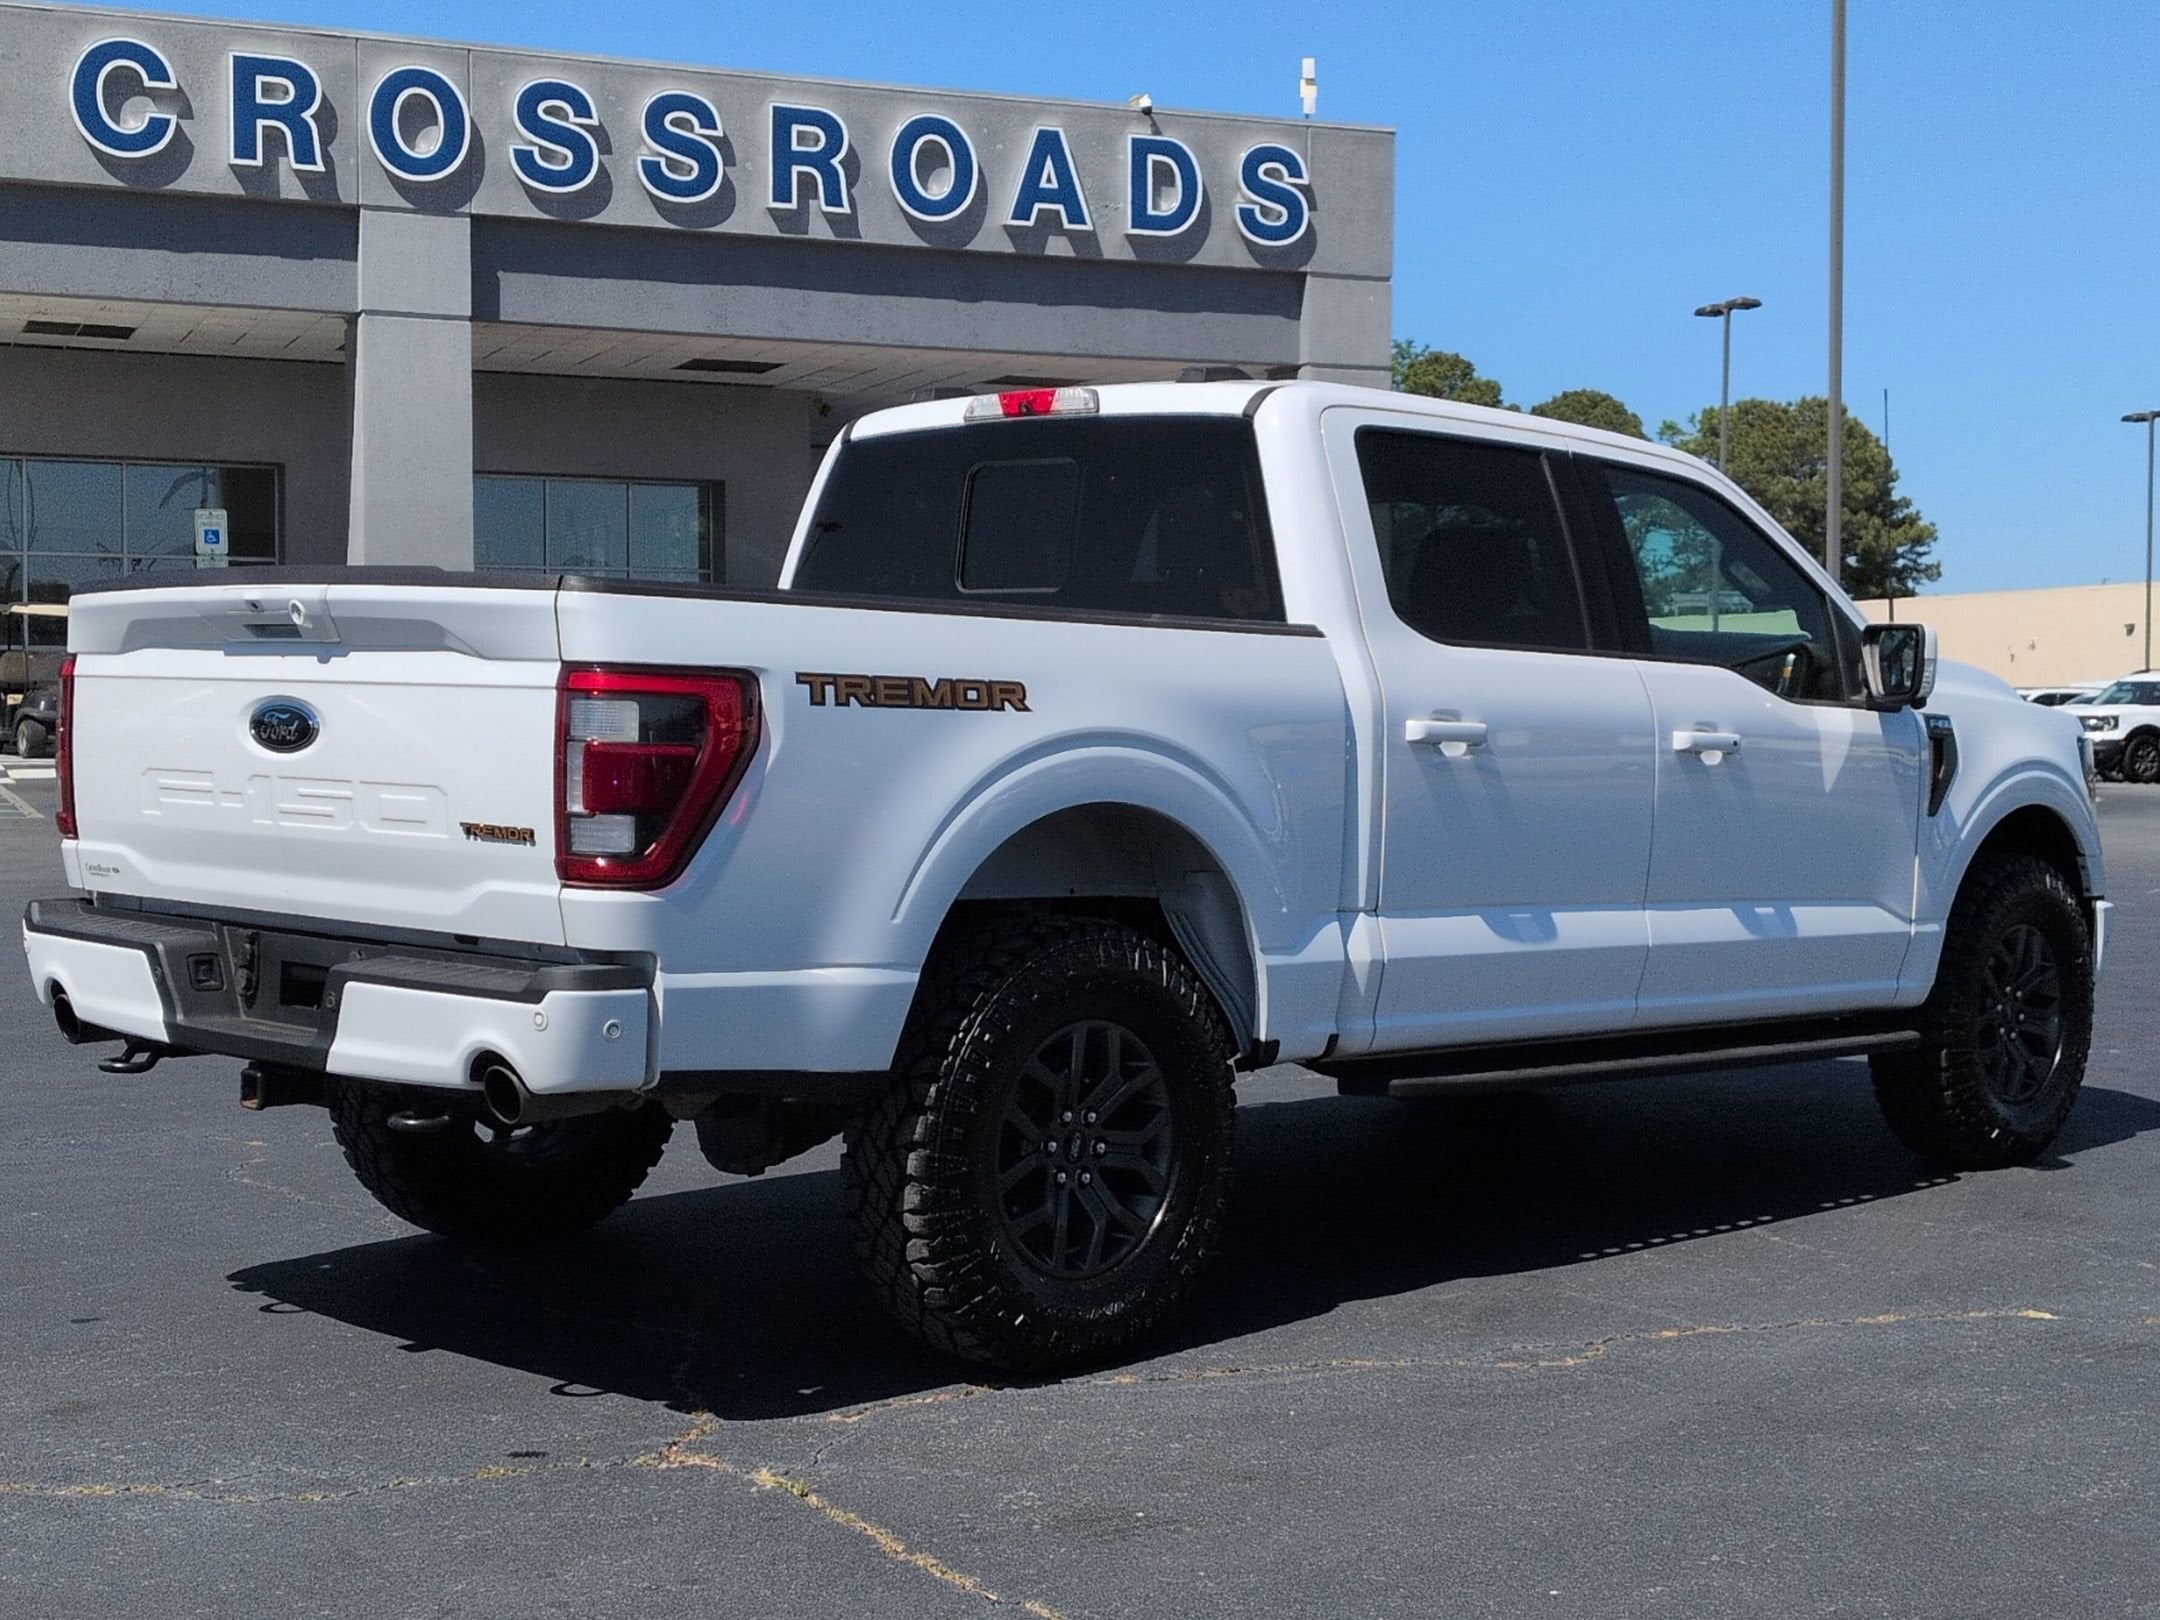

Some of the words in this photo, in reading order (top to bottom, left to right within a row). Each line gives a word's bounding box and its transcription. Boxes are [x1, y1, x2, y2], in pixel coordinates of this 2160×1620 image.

[69, 37, 1311, 247] CROSSROADS
[795, 671, 1033, 712] TREMOR
[261, 711, 299, 740] Ford
[142, 768, 450, 838] F-150
[459, 821, 536, 845] TREMOR
